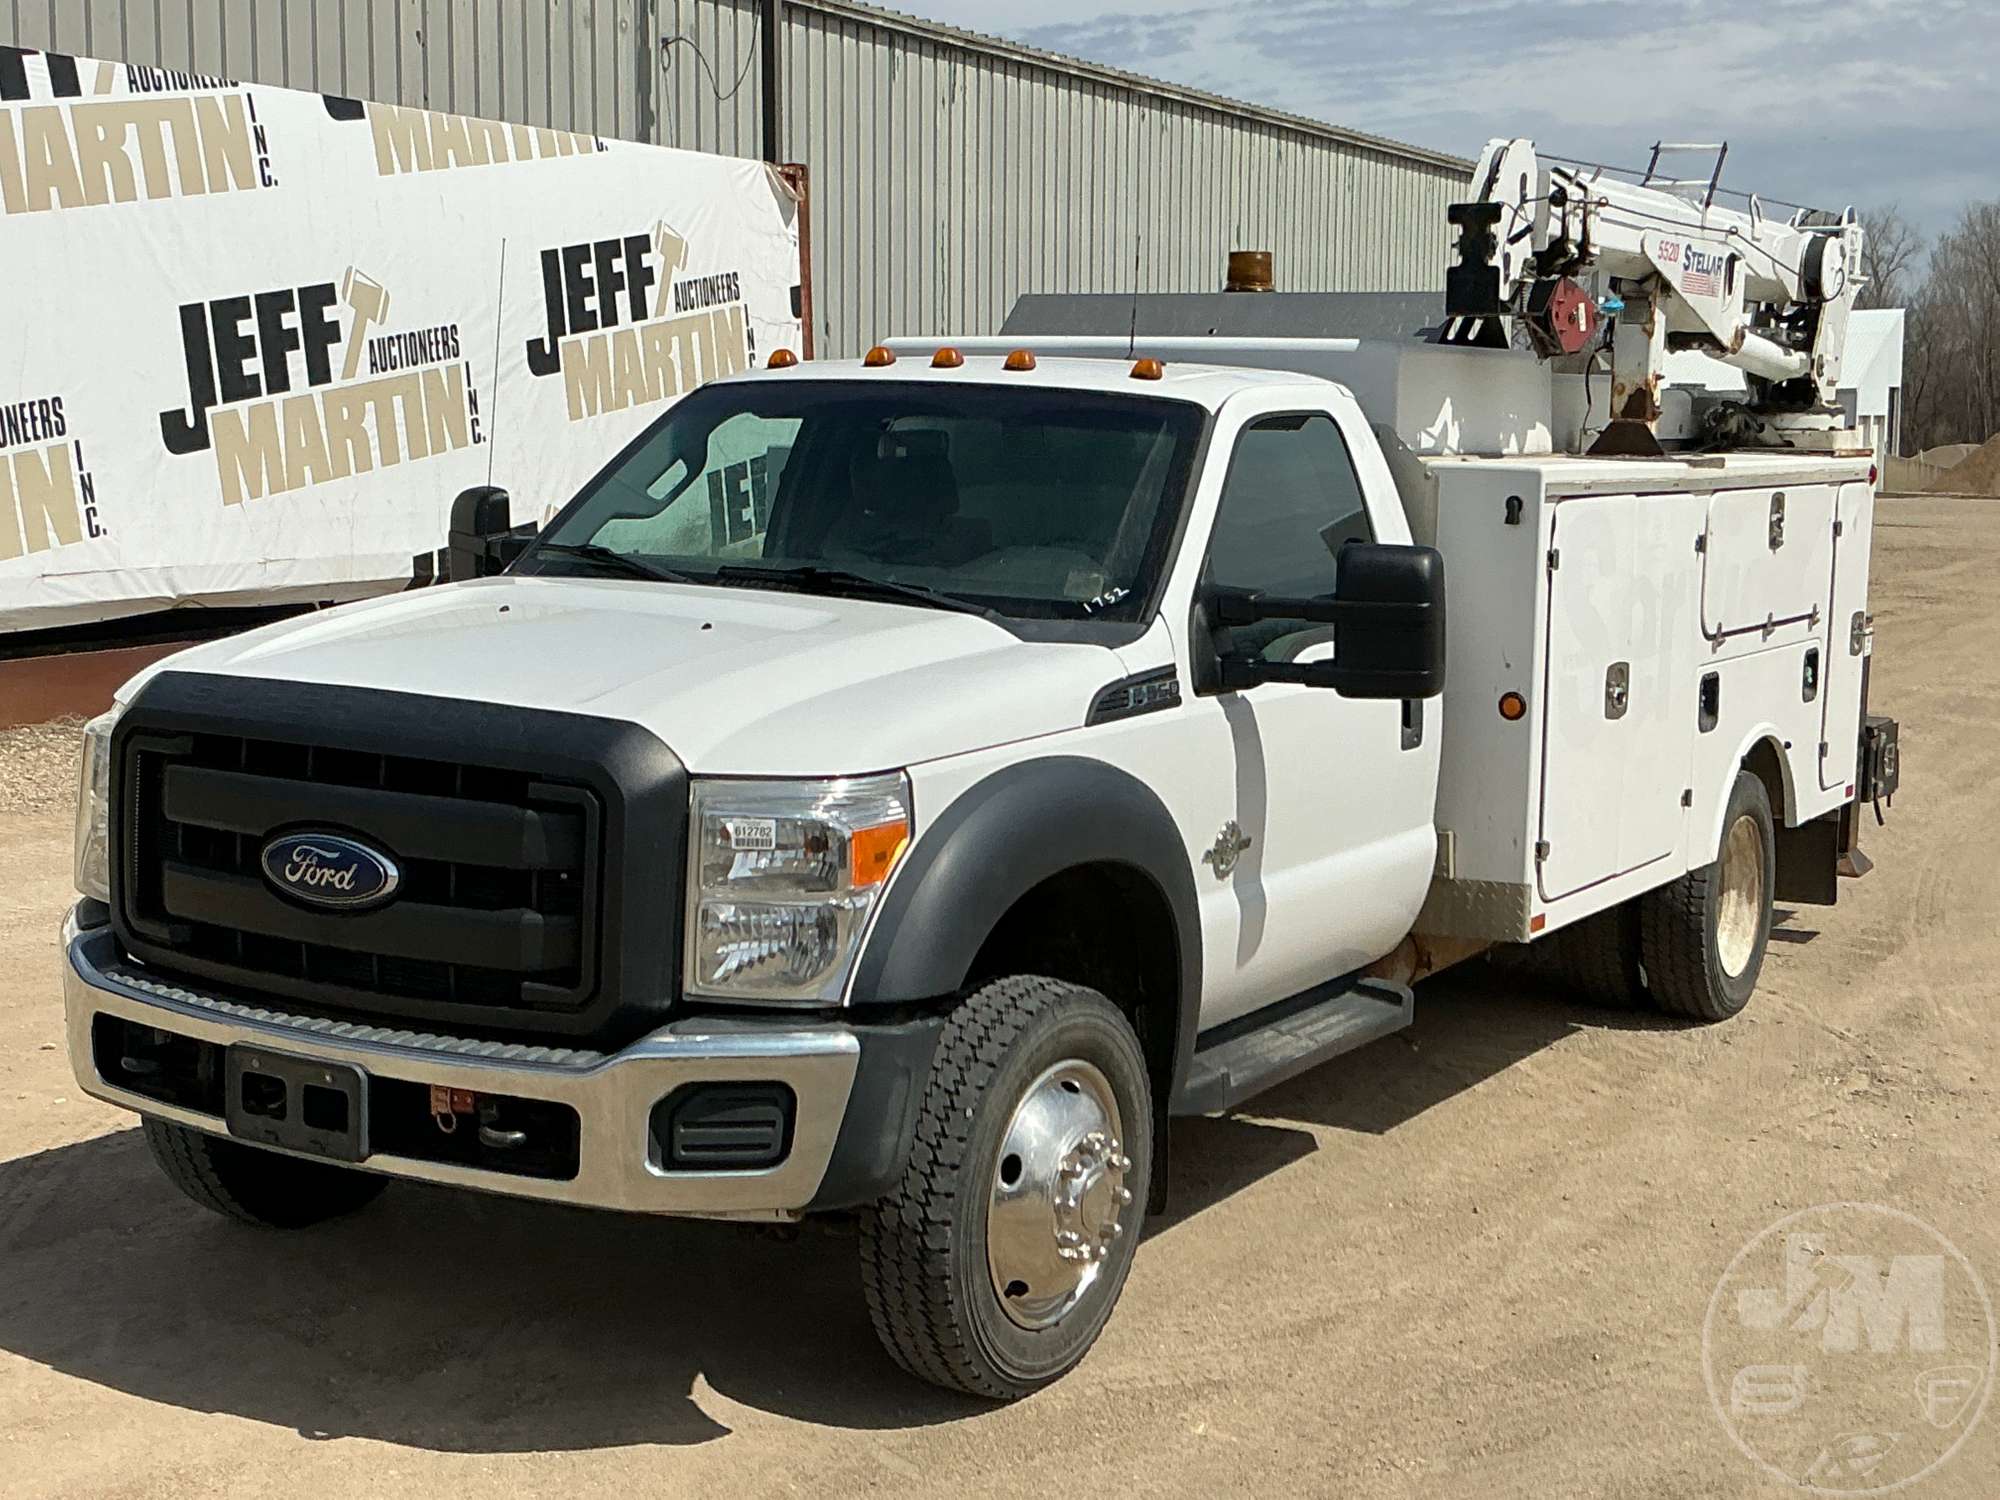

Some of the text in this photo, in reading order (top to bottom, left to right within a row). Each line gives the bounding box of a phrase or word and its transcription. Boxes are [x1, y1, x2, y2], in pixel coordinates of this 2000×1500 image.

[1658, 239, 1680, 263] 5520
[526, 233, 655, 377] JEFF
[674, 271, 741, 314] AUCTIONEERS
[159, 282, 342, 456] JEFF
[368, 323, 461, 375] AUCTIONEERS
[562, 305, 748, 422] MARTIN
[211, 363, 469, 507] MARTIN
[1083, 586, 1131, 613] 1752
[285, 844, 359, 891] Ford
